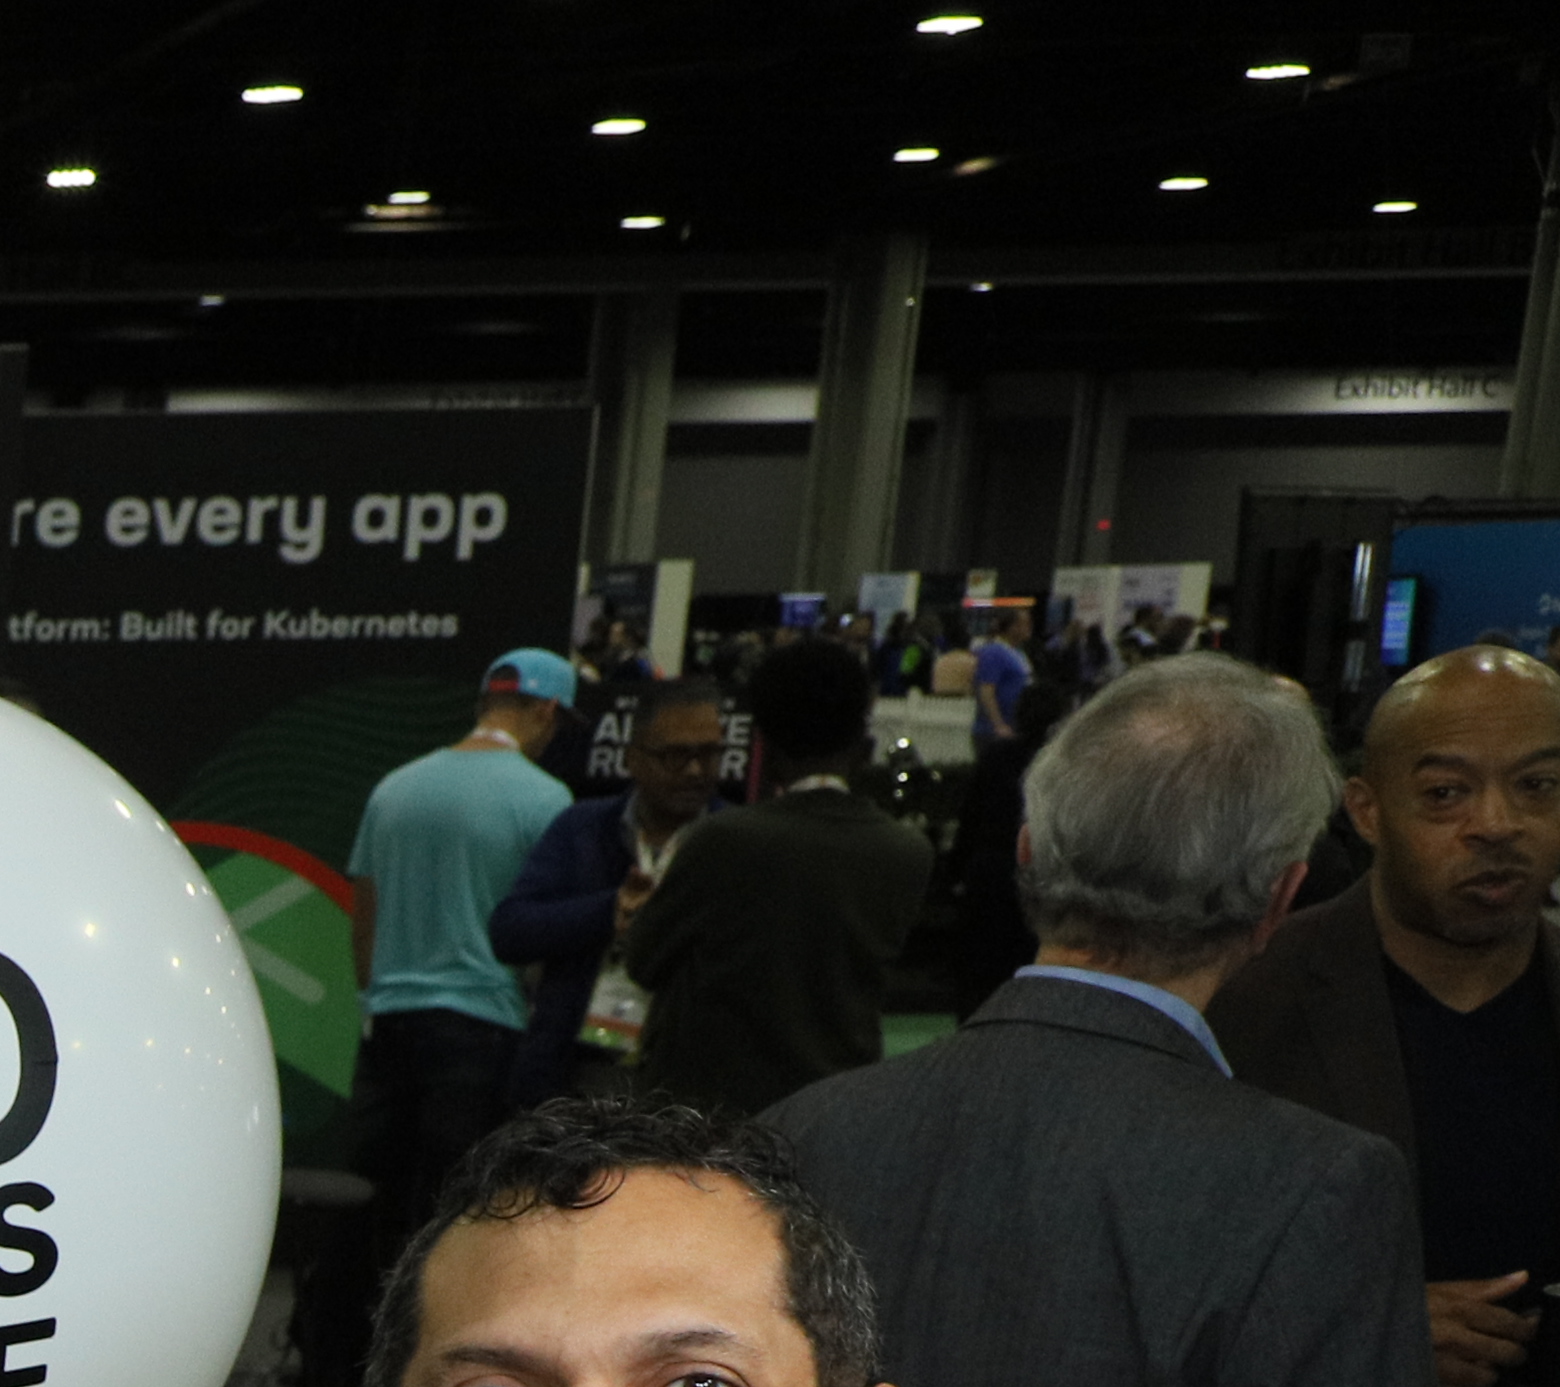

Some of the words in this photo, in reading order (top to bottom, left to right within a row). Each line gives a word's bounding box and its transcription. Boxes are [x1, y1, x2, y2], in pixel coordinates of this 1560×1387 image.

[104, 494, 327, 565] every
[351, 491, 509, 562] app
[118, 610, 198, 641] Built
[206, 609, 255, 640] for
[263, 608, 459, 640] Kubernetes
